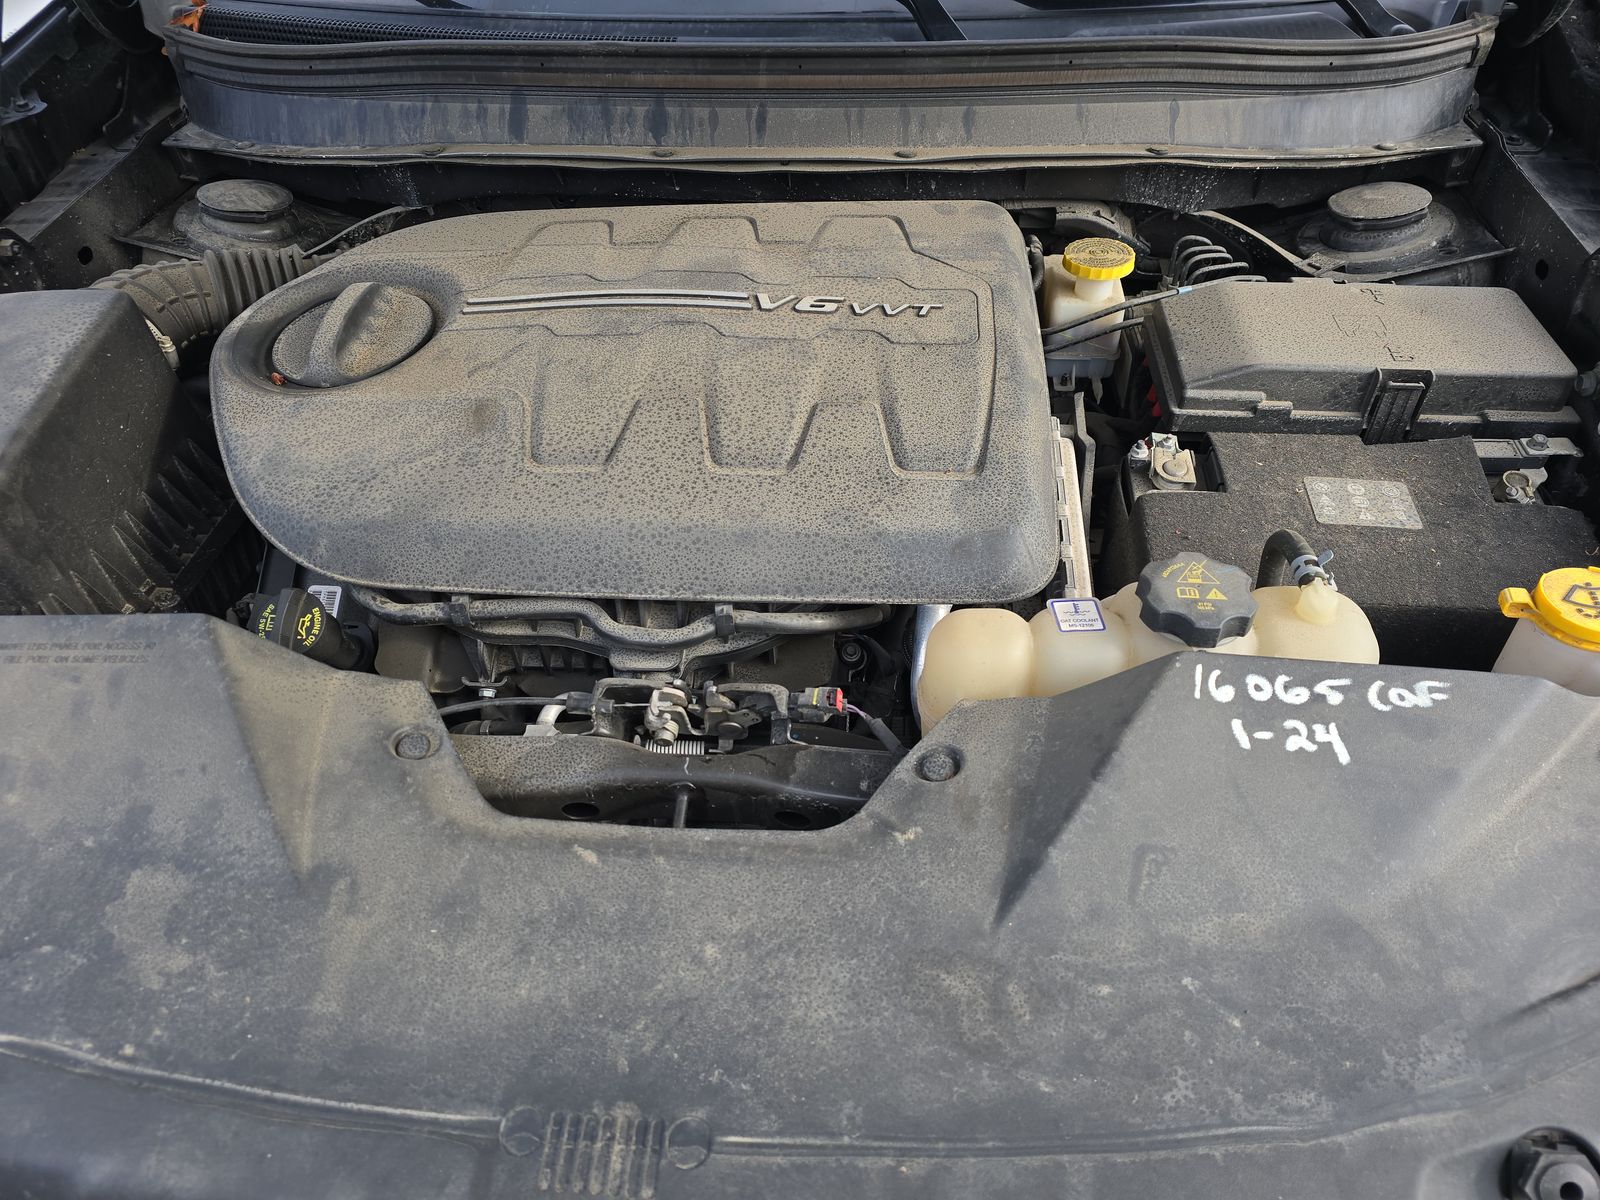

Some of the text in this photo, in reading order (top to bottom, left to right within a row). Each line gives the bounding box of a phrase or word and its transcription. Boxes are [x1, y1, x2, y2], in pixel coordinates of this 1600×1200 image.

[755, 292, 944, 317] V6 VVT
[262, 603, 275, 617] SAE
[302, 607, 322, 648] ENGINE OIL
